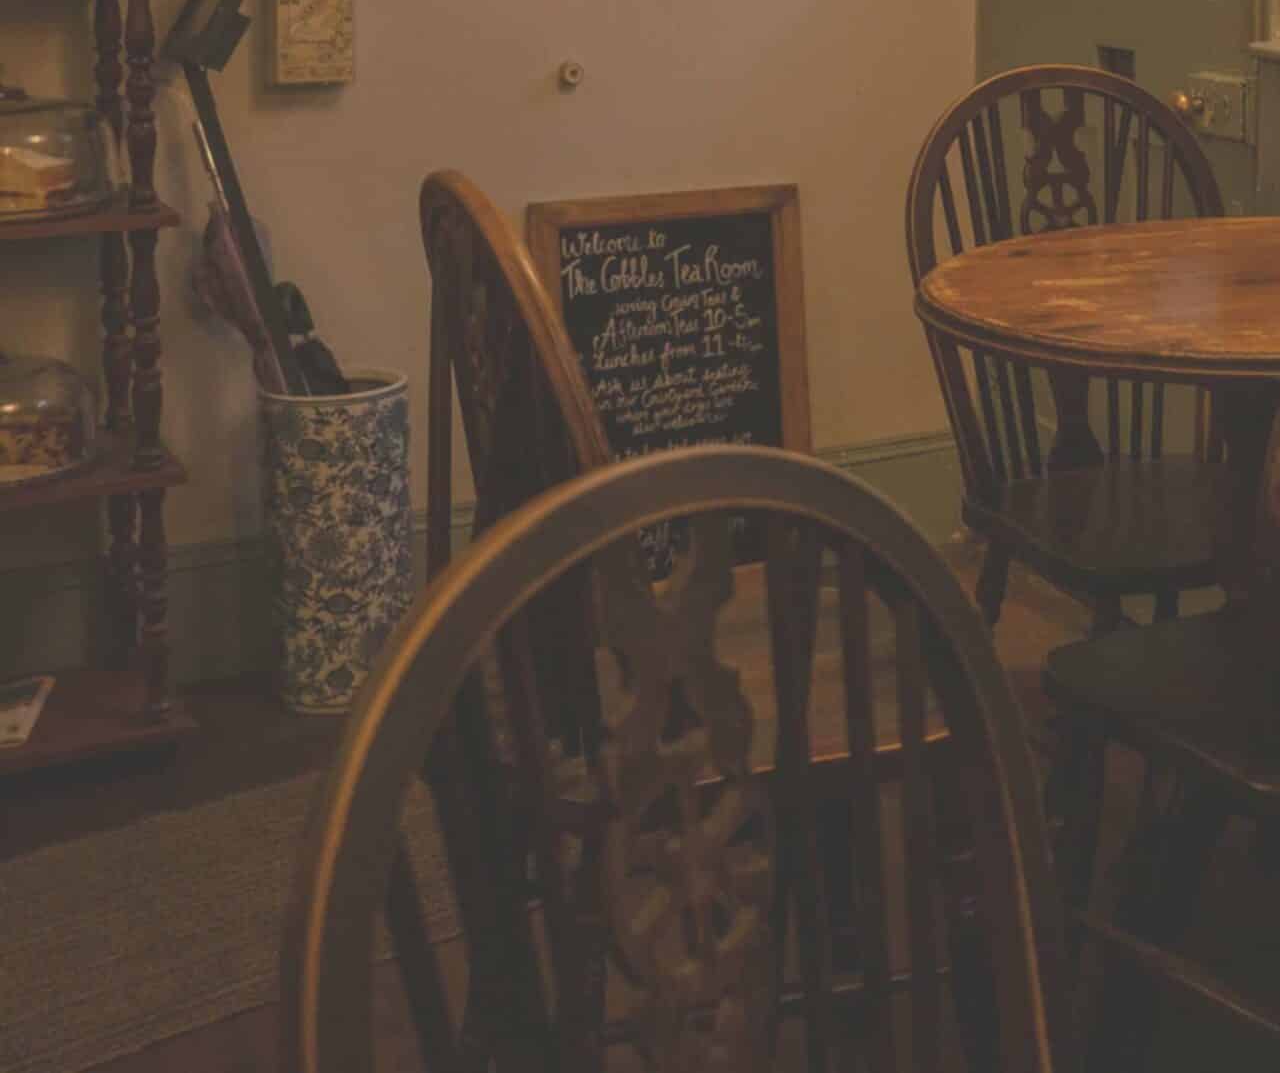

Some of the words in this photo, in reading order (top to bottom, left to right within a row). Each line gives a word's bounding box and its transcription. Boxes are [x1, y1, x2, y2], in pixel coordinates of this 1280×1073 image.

[561, 230, 639, 258] Welcome
[647, 228, 666, 248] to
[560, 258, 598, 301] The
[601, 255, 664, 293] Cobbles
[664, 243, 704, 290] Tea
[705, 244, 761, 286] Room
